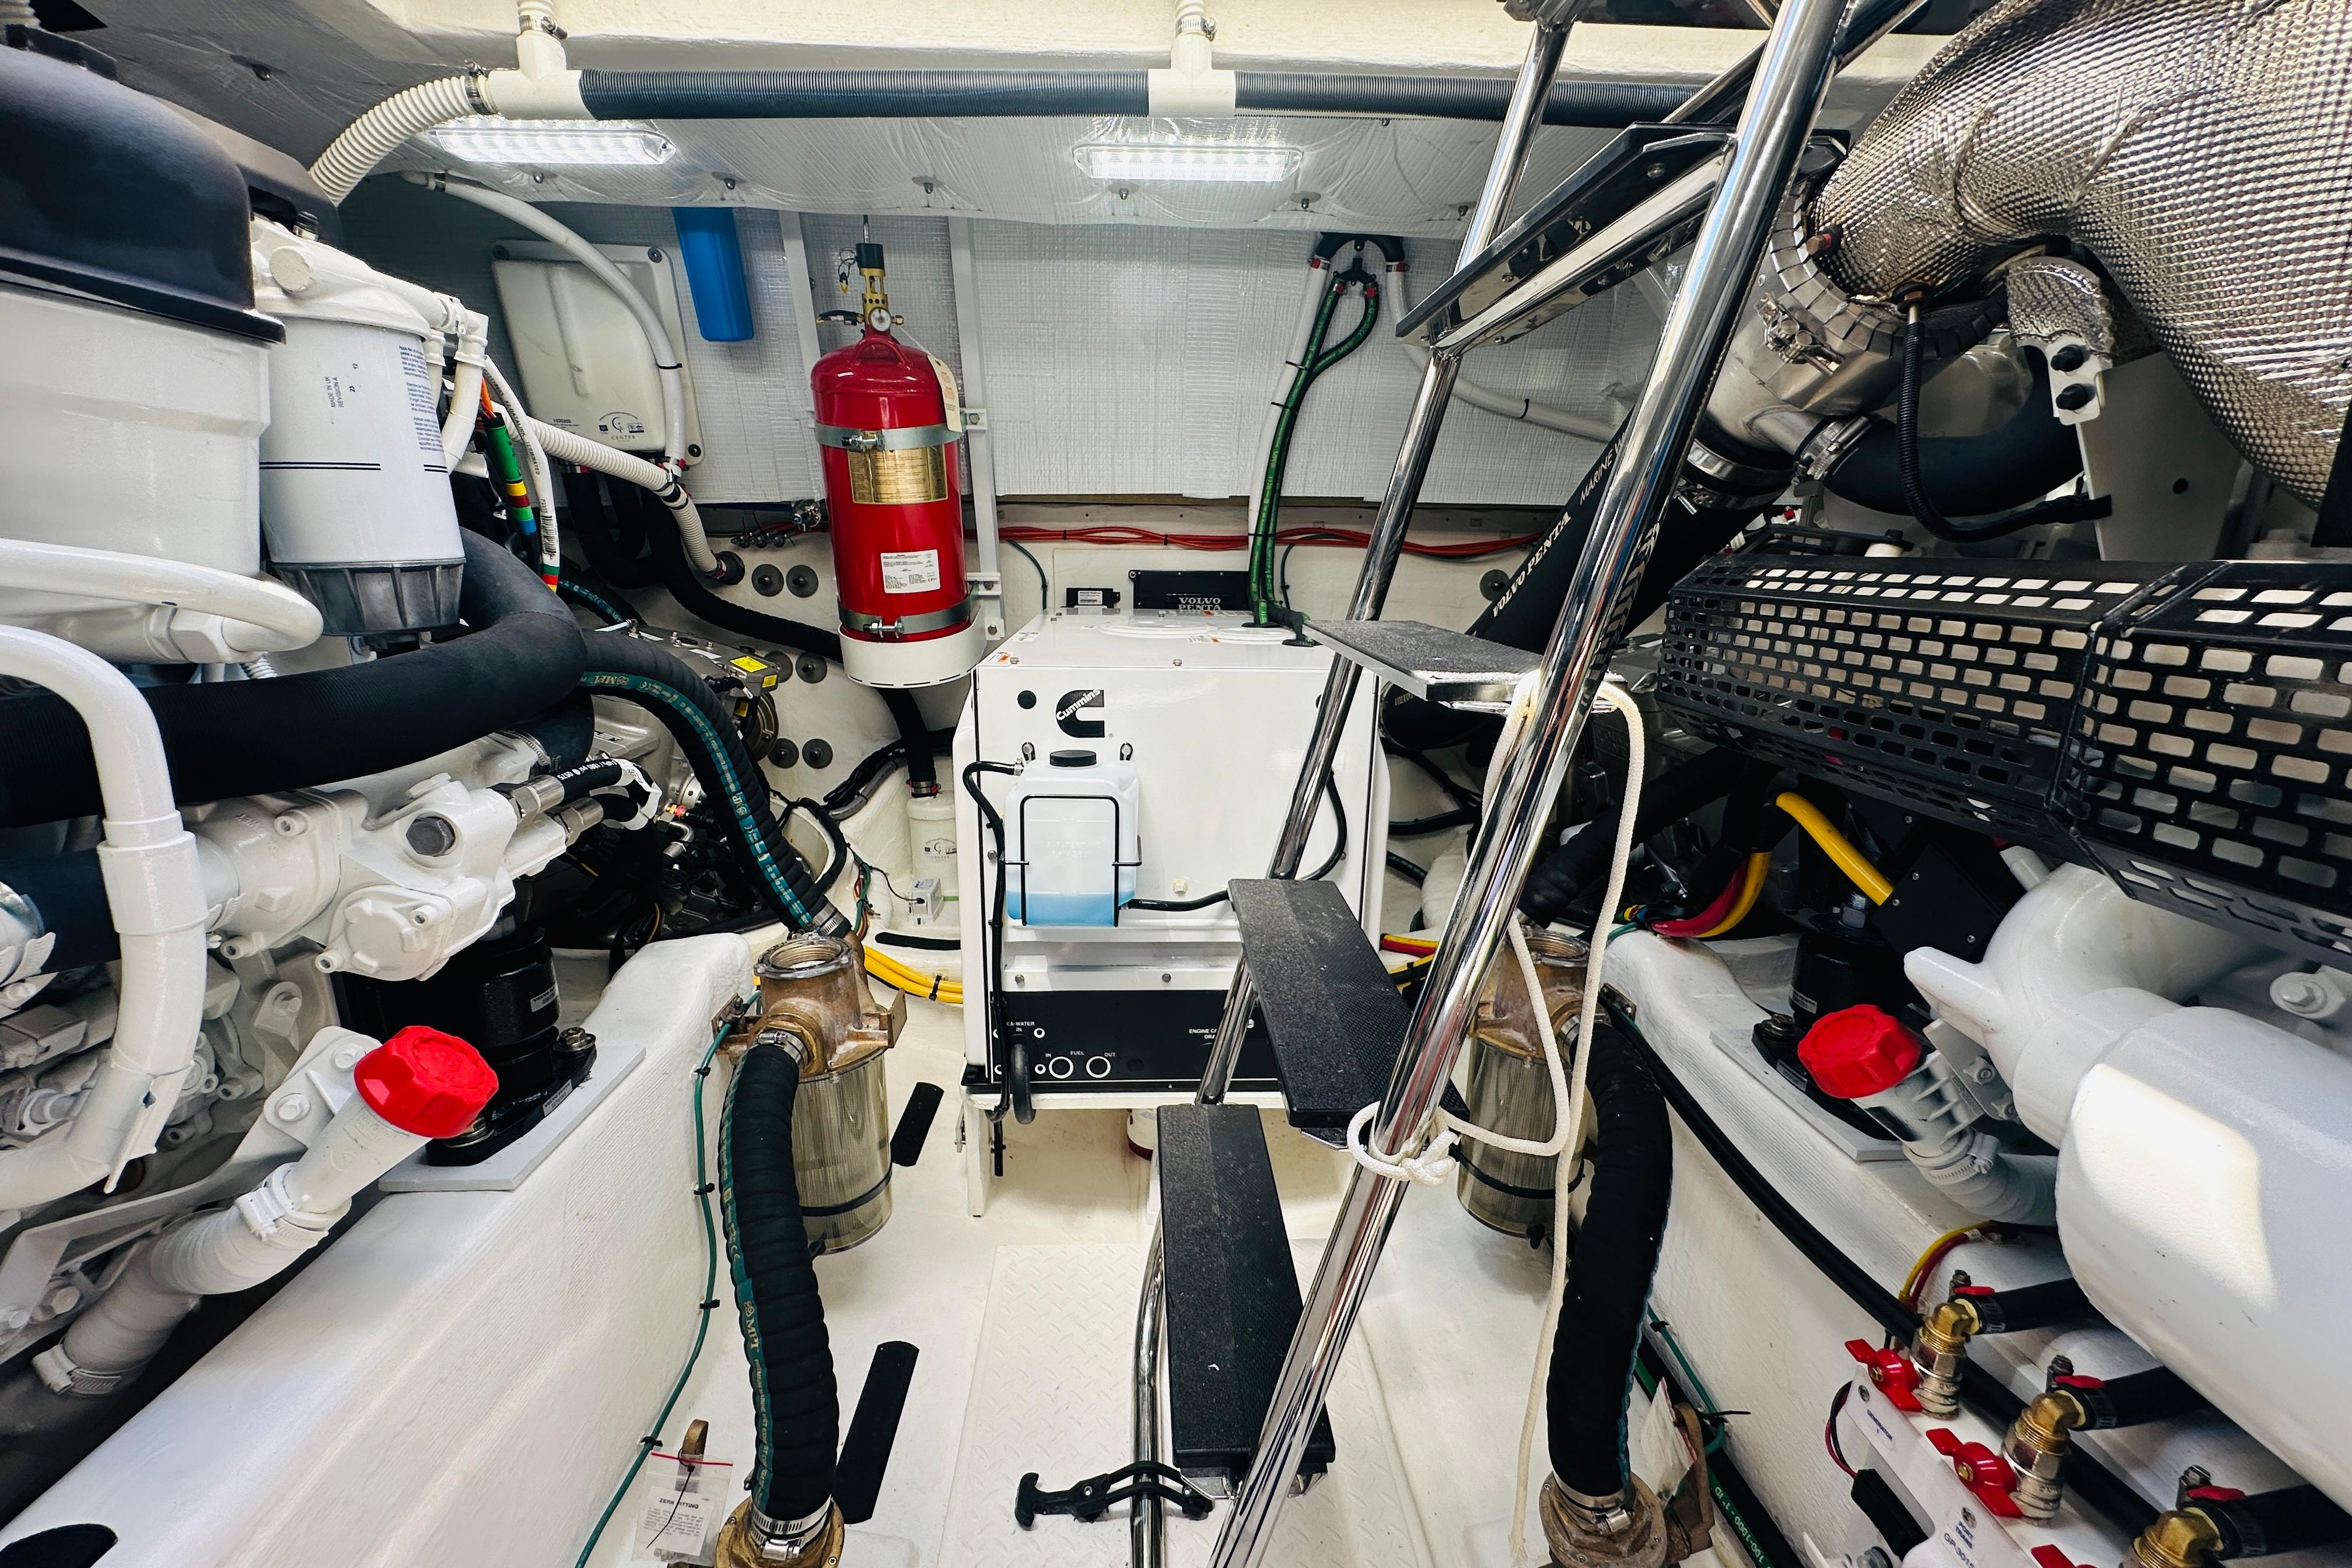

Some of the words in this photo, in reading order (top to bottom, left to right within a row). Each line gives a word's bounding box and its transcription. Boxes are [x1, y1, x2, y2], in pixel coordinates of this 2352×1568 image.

[1580, 448, 1614, 505] MARINE
[1492, 570, 1526, 618] VOLVO
[1527, 511, 1572, 576] PENTA
[1056, 690, 1101, 720] Cummins
[746, 1317, 759, 1349] MPI
[659, 1497, 675, 1506] ZERK
[678, 1501, 699, 1510] ITTING
[1715, 1486, 1724, 1500] ID
[1735, 1516, 1765, 1563] 100-1000
